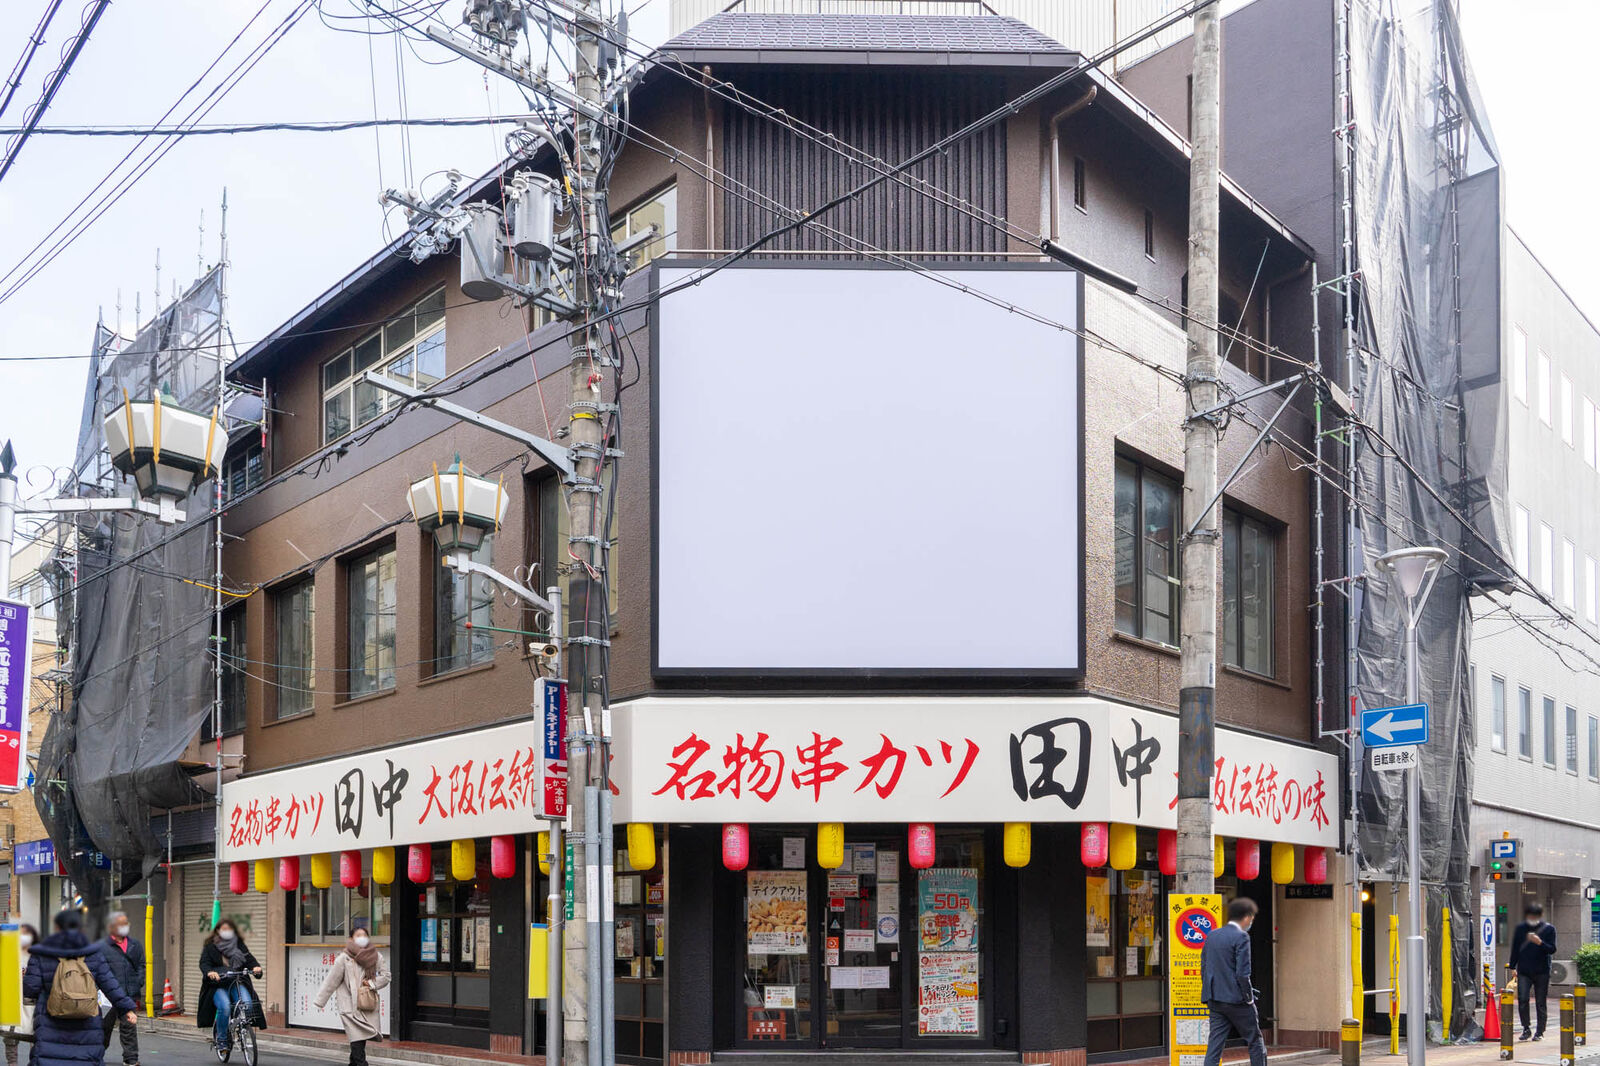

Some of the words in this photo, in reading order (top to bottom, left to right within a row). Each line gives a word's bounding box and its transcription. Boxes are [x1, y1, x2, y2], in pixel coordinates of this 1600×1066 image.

[1373, 751, 1415, 766] 自転車を除く
[651, 731, 980, 803] 名物串カツ
[1010, 717, 1161, 819] 田中
[545, 779, 568, 790] たかつ
[227, 792, 324, 849] 名物串カツ
[334, 758, 409, 840] 田中
[554, 787, 565, 814] 本通り
[1494, 843, 1513, 857] P
[751, 885, 805, 897] テイクアウト
[934, 893, 970, 910] 50円
[1172, 896, 1221, 914] 放置禁止
[1484, 922, 1492, 941] P
